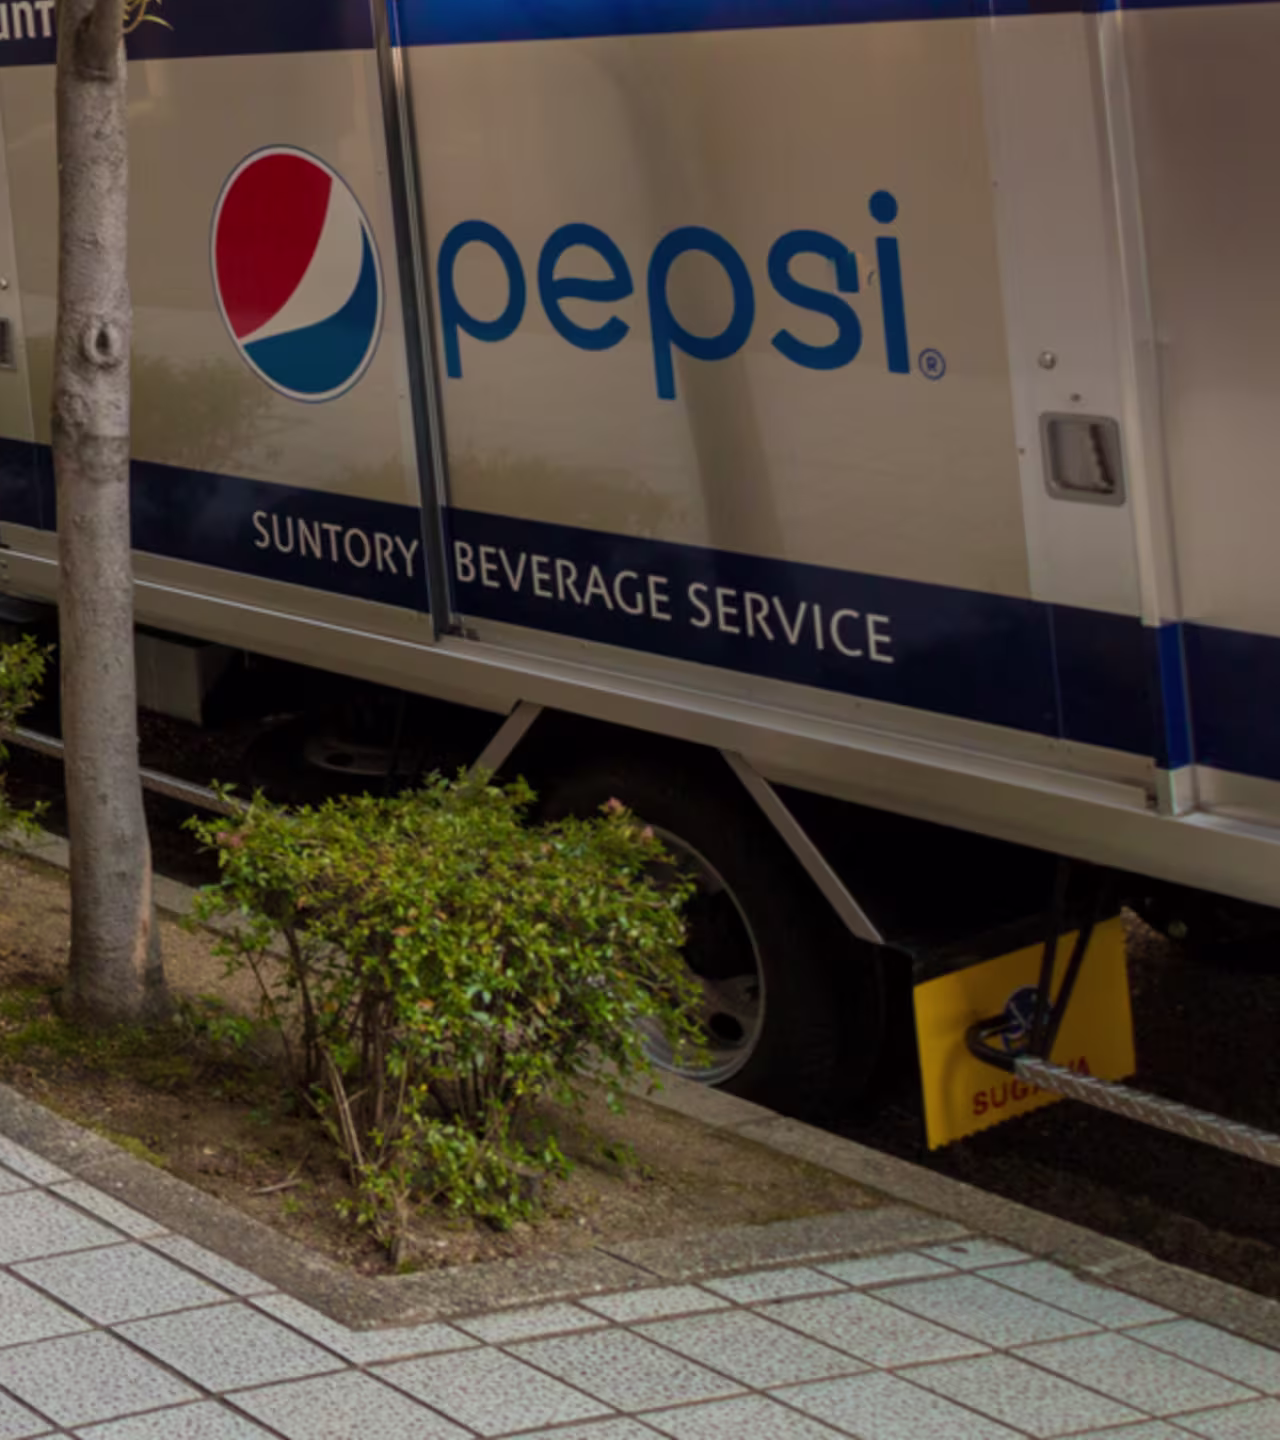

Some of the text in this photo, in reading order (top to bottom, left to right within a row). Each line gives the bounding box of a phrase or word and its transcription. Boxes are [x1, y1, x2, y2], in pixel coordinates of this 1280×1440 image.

[437, 189, 911, 400] pepsi
[251, 509, 895, 664] SUNTORY BEVERAGE SERVICE
